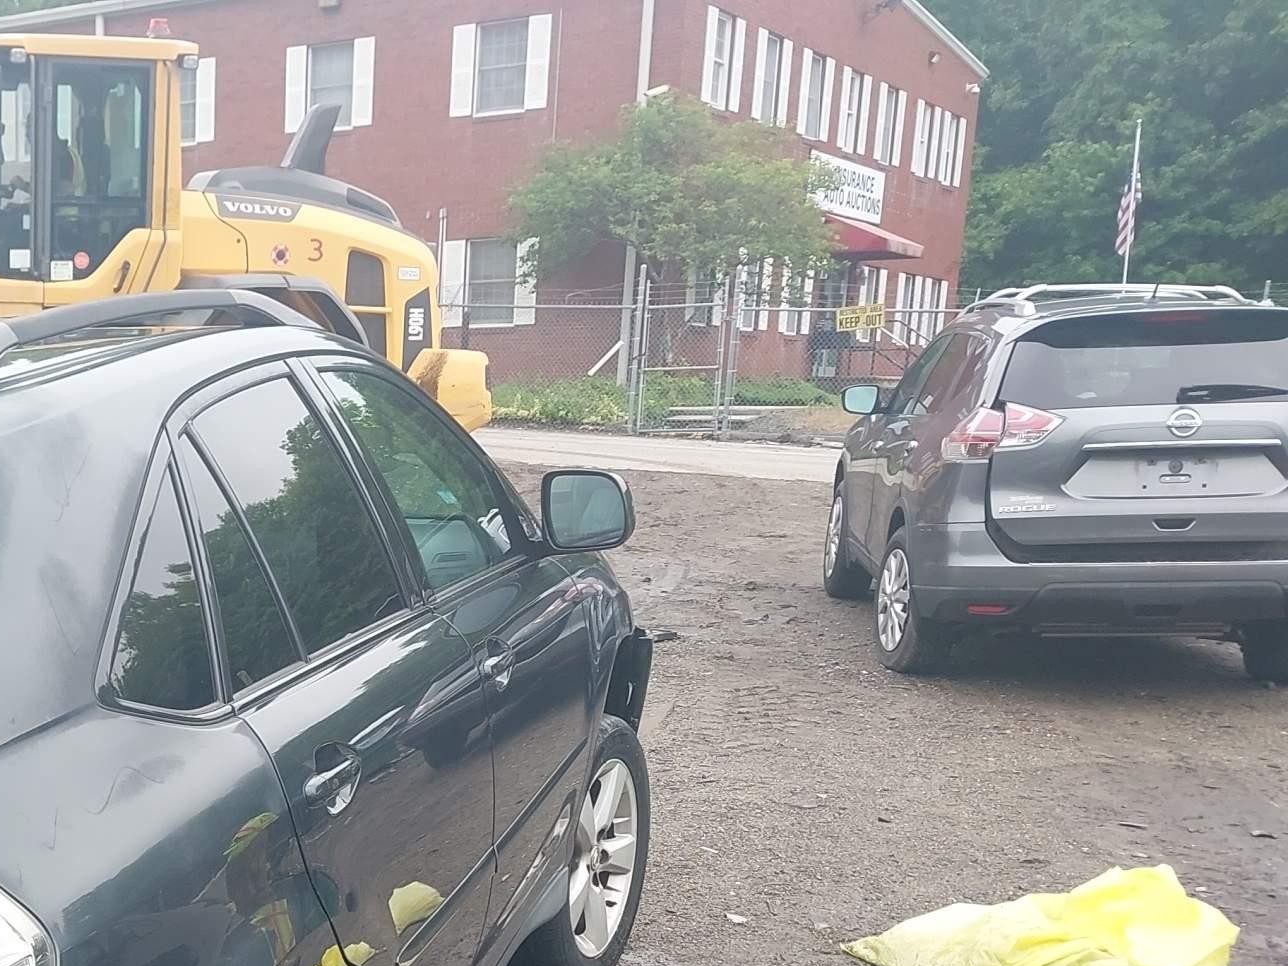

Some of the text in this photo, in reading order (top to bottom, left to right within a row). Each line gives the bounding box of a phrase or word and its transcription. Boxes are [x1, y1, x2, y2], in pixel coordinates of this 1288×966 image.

[832, 166, 875, 193] NSURANCE
[223, 200, 293, 217] VOLVO
[823, 188, 880, 216] AUTO AUCTIONS
[307, 238, 323, 262] 3
[408, 308, 424, 341] L90H
[839, 313, 882, 329] KEEP OUT
[998, 503, 1057, 513] ROGUE
